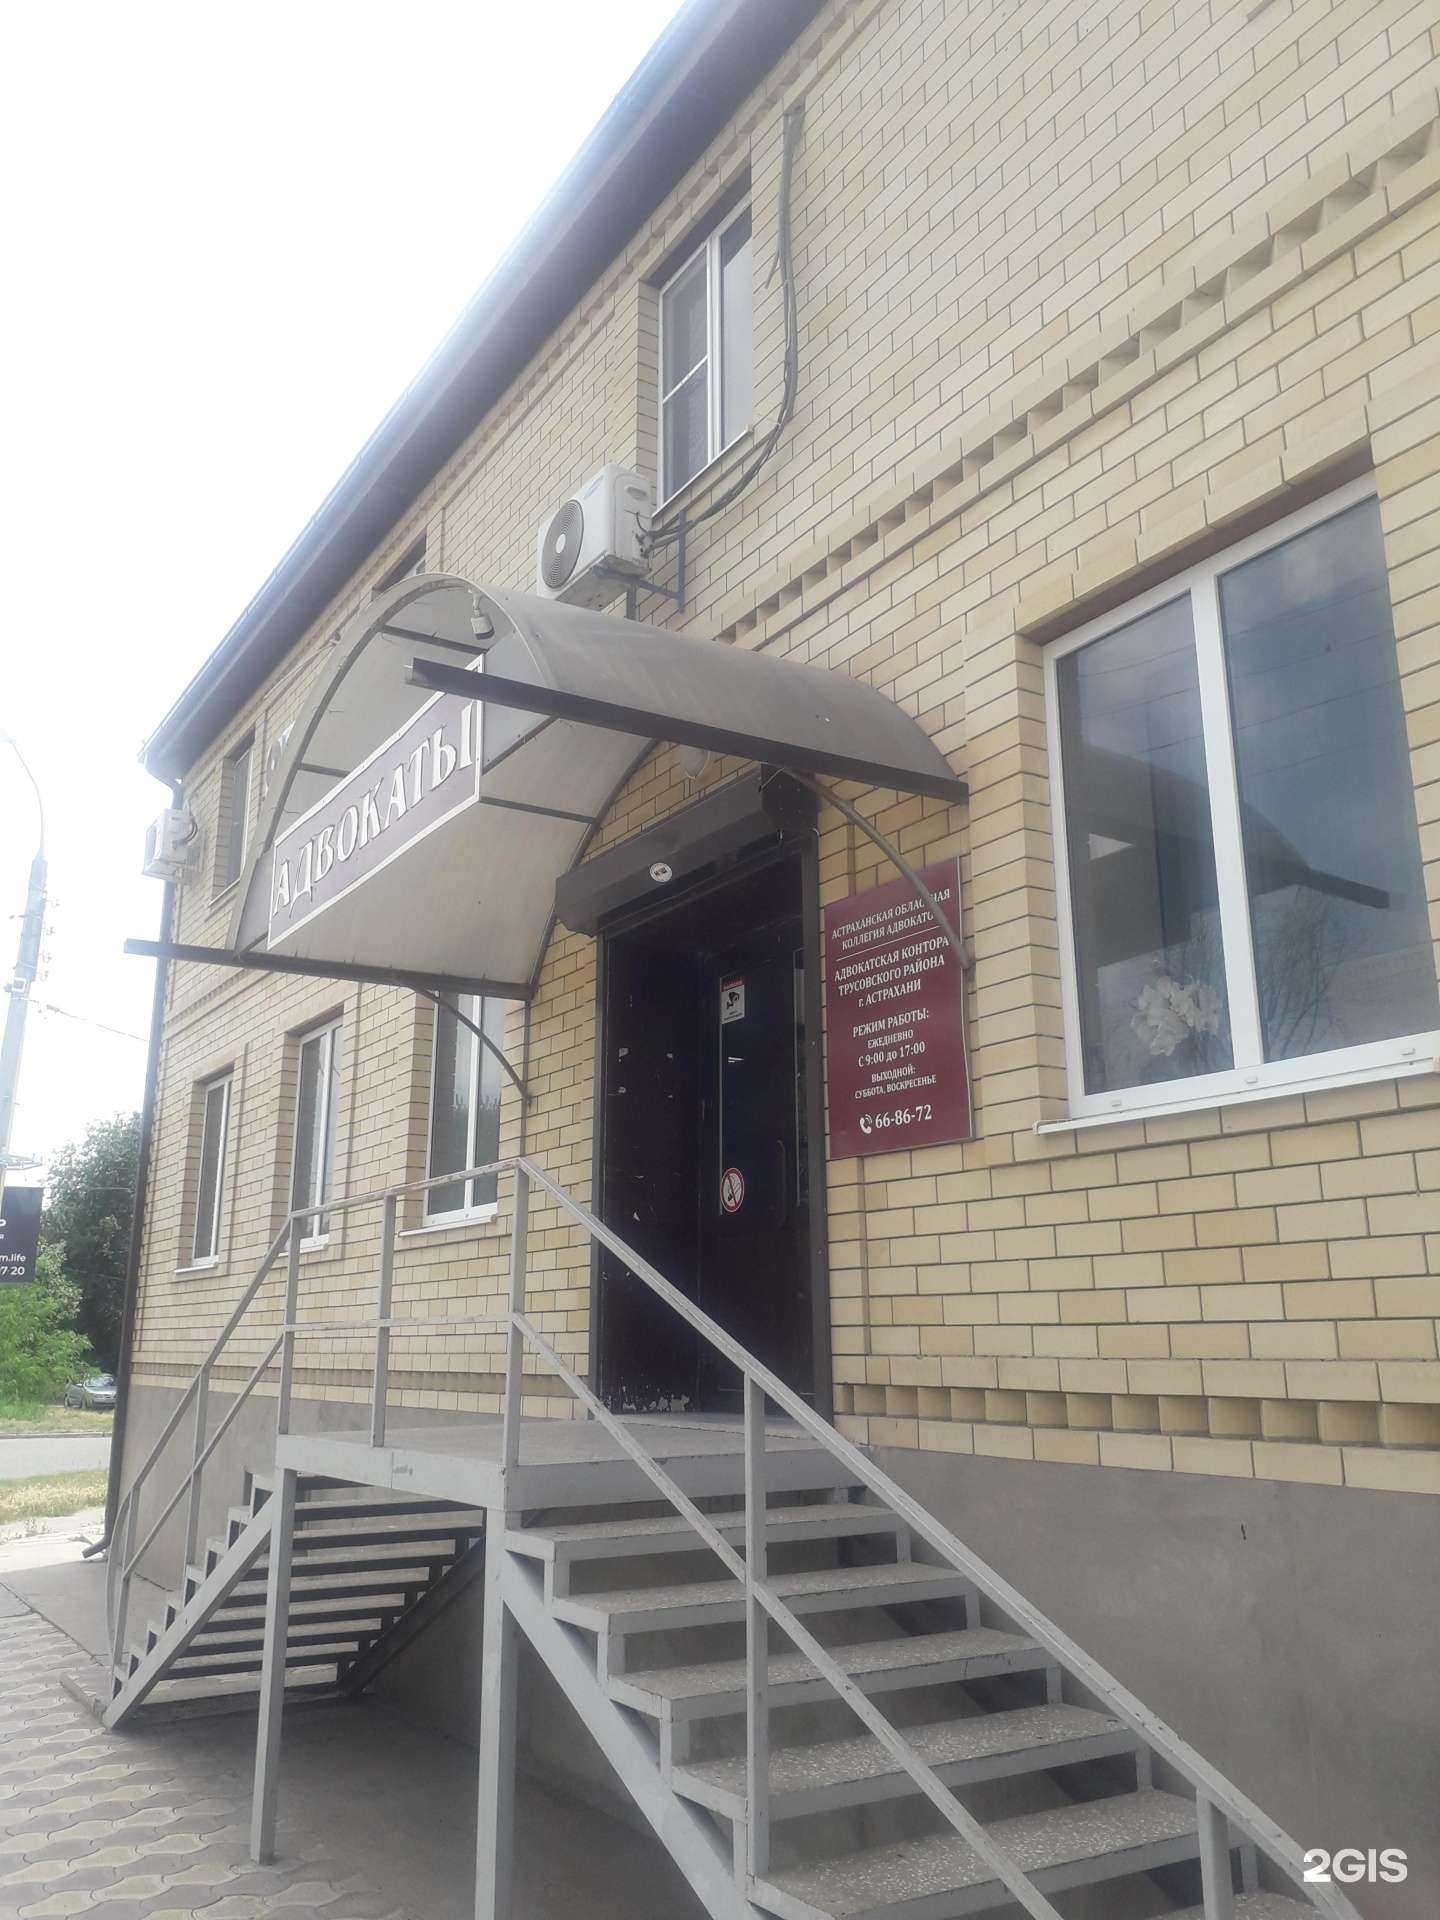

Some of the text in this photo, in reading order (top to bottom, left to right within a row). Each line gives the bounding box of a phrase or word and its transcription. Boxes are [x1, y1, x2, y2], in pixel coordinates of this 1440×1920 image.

[273, 699, 475, 919] АДВОКАТЫ
[832, 888, 950, 940] АСТРАХАНСКАЯ ОБЛАСНАЯ
[842, 911, 935, 951] КОЛЛЕГИЯ АДВОКАТО
[834, 936, 950, 982] АДВОКАТСКАЯ КОНТОРА
[838, 954, 945, 996] ТРУСОВСКОГО РАЙОНА
[865, 978, 921, 1006] АСТРАХАНИ
[853, 1008, 929, 1038] РЕЖИМ РАБОТЫ:
[867, 1029, 914, 1049] ЕЖЕДНЕВНО
[865, 1052, 884, 1066] 9:00
[886, 1050, 897, 1063] до
[900, 1041, 926, 1058] 17:00
[871, 1063, 917, 1083] ВЫХОДНОЙ:
[887, 1074, 937, 1093] ВОСКРЕСЕНЬЕ
[875, 1104, 932, 1129] 66-86-72
[11, 1266, 25, 1275] 20
